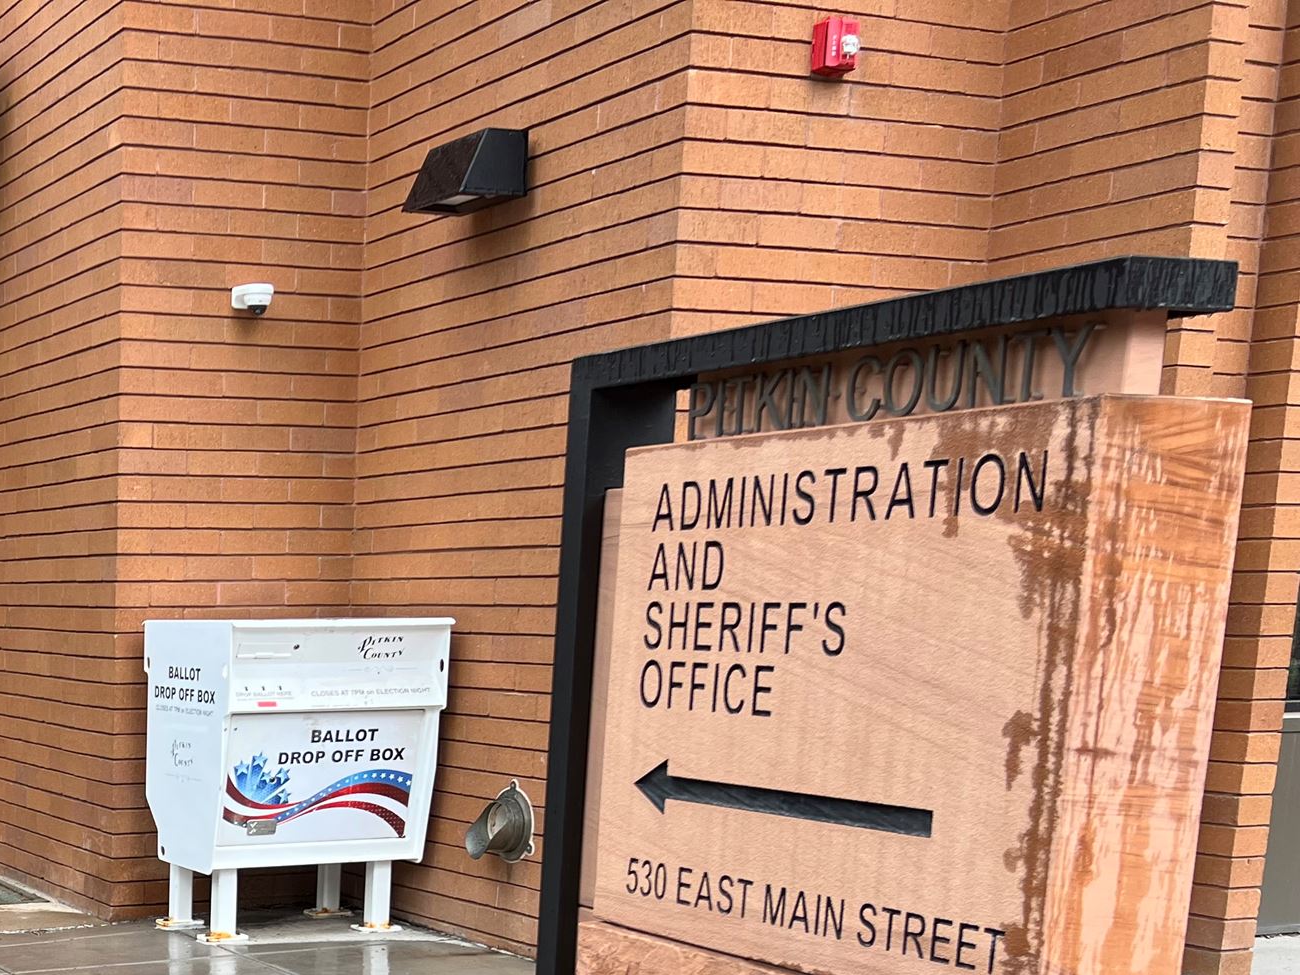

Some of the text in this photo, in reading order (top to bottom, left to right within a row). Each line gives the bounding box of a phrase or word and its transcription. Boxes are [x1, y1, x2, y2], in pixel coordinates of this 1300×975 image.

[687, 322, 1098, 441] PITKIN COUNTY
[652, 449, 1049, 533] ADMINISTRATION
[647, 540, 725, 591] AND
[357, 635, 404, 653] PITKIN
[643, 600, 847, 657] SHERIFF'S
[363, 647, 405, 660] COUNTY
[168, 665, 201, 682] BALLOT
[640, 659, 775, 717] OFFICE
[154, 685, 215, 705] DROP OFF BOX
[311, 728, 379, 744] BALLOT
[278, 747, 406, 765] DROP OFF BOX
[626, 857, 1006, 975] 530 EAST MAIN STREET
